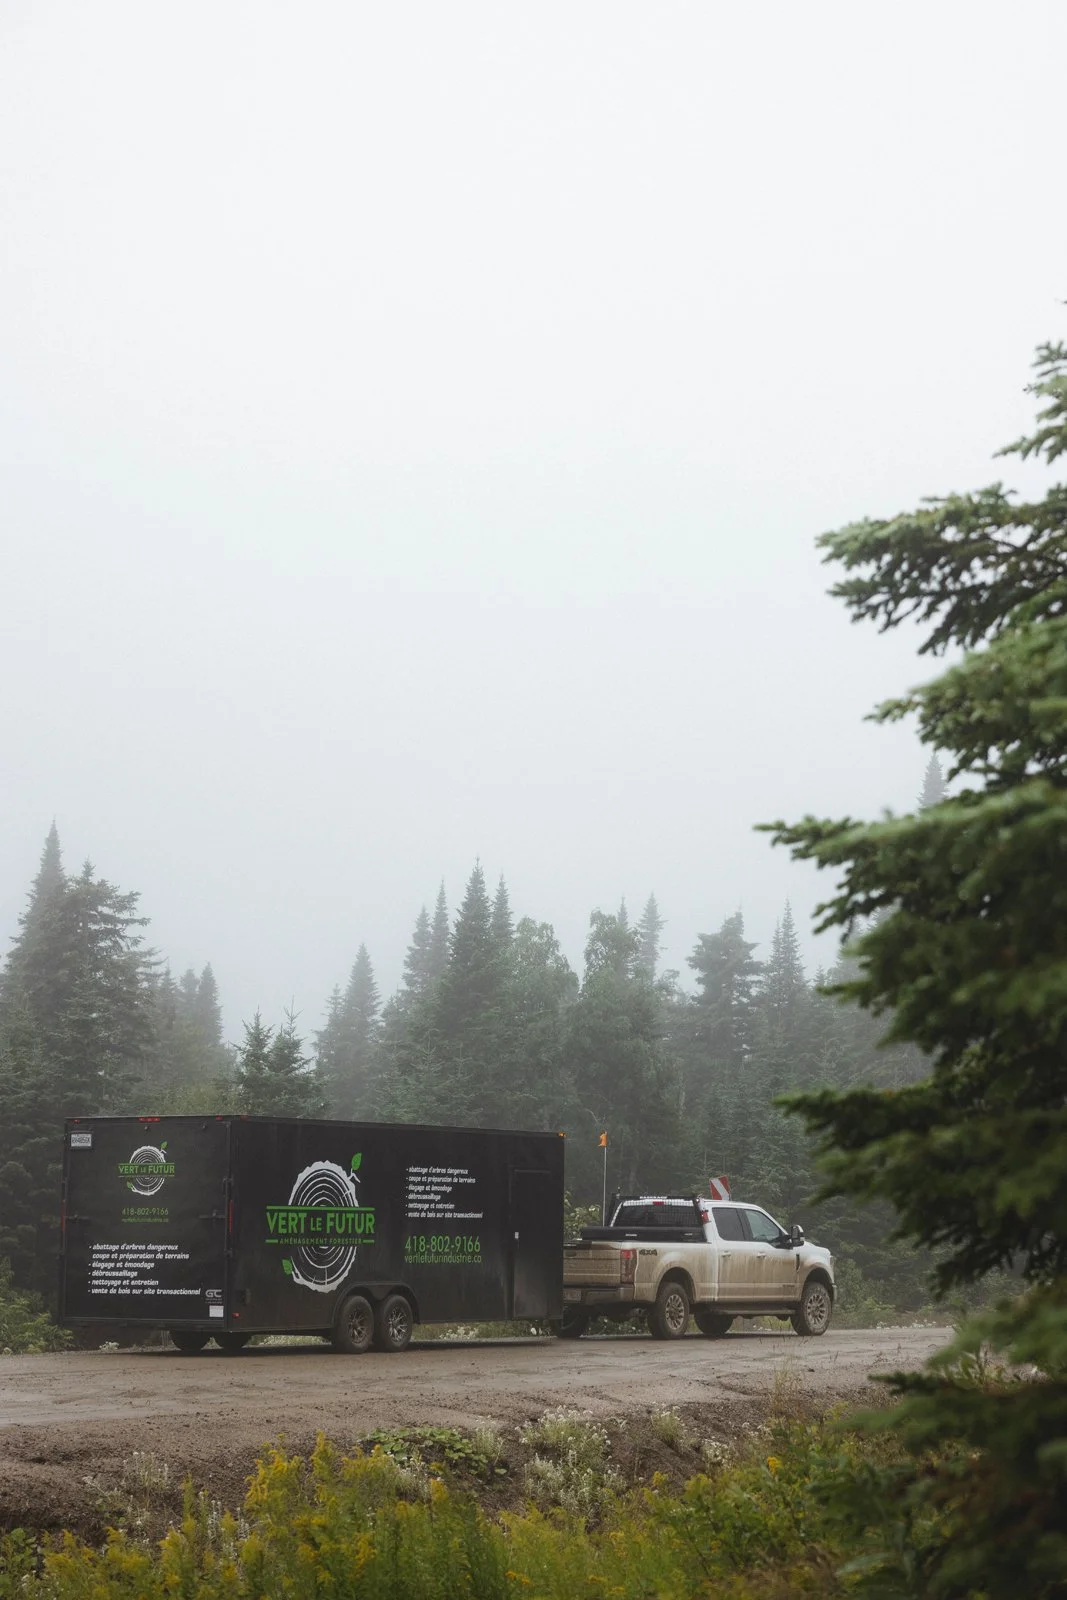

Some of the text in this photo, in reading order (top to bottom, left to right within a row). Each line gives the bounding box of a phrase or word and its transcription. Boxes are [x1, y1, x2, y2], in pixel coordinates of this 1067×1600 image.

[118, 1165, 139, 1174] VERT
[148, 1165, 175, 1174] FUTUR
[408, 1165, 428, 1174] abattage
[121, 1207, 169, 1216] 418-802-9166
[266, 1212, 375, 1234] VERT LE FUTUR
[92, 1243, 178, 1252] abattage d'arbres dangereux
[404, 1235, 480, 1252] 418-802-9166
[119, 1252, 154, 1260] préparation
[165, 1252, 190, 1260] terrains
[92, 1261, 115, 1269] élagage
[124, 1261, 155, 1269] émondage
[91, 1270, 138, 1278] débroussaillage
[91, 1279, 121, 1287] nettoyage
[205, 1289, 222, 1298] GC
